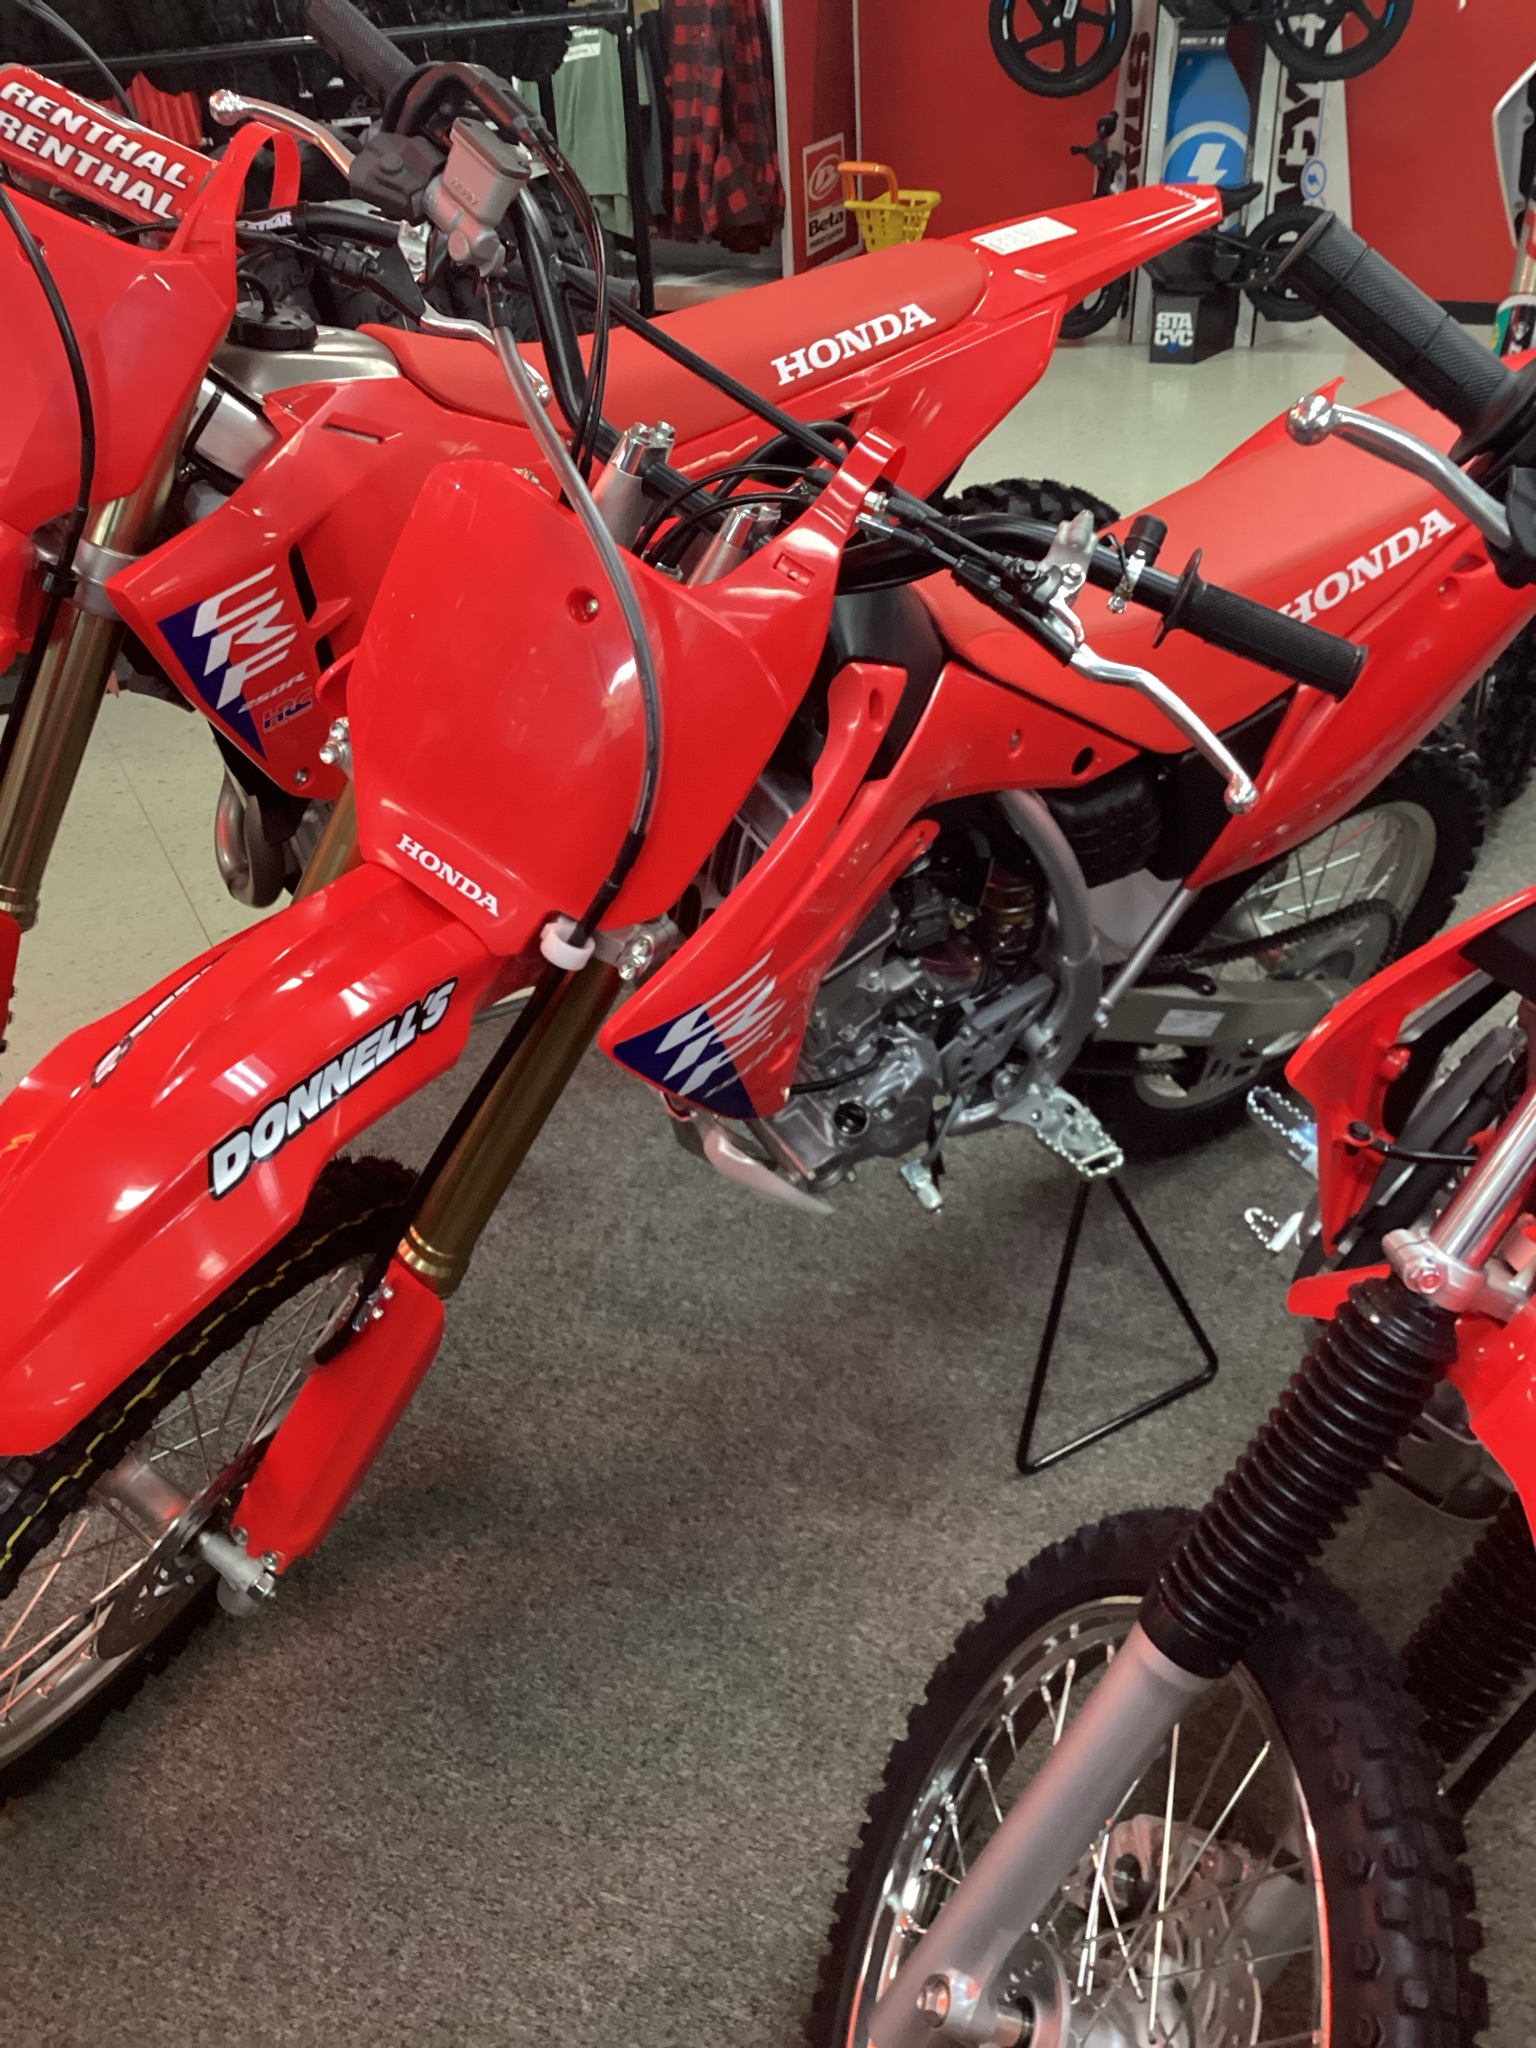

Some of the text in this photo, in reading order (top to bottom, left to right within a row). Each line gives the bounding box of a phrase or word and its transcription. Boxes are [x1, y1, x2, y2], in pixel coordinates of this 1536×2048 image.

[0, 81, 187, 190] RENTHAL
[0, 110, 176, 219] RENTHAL
[808, 211, 845, 238] Beta
[770, 303, 937, 386] HONDA
[1154, 329, 1194, 347] CYC
[1156, 312, 1193, 329] STA
[1277, 508, 1457, 624] HONDA
[192, 563, 299, 711] CRF
[396, 833, 500, 918] HONDA
[209, 978, 458, 1199] DONNELL'S
